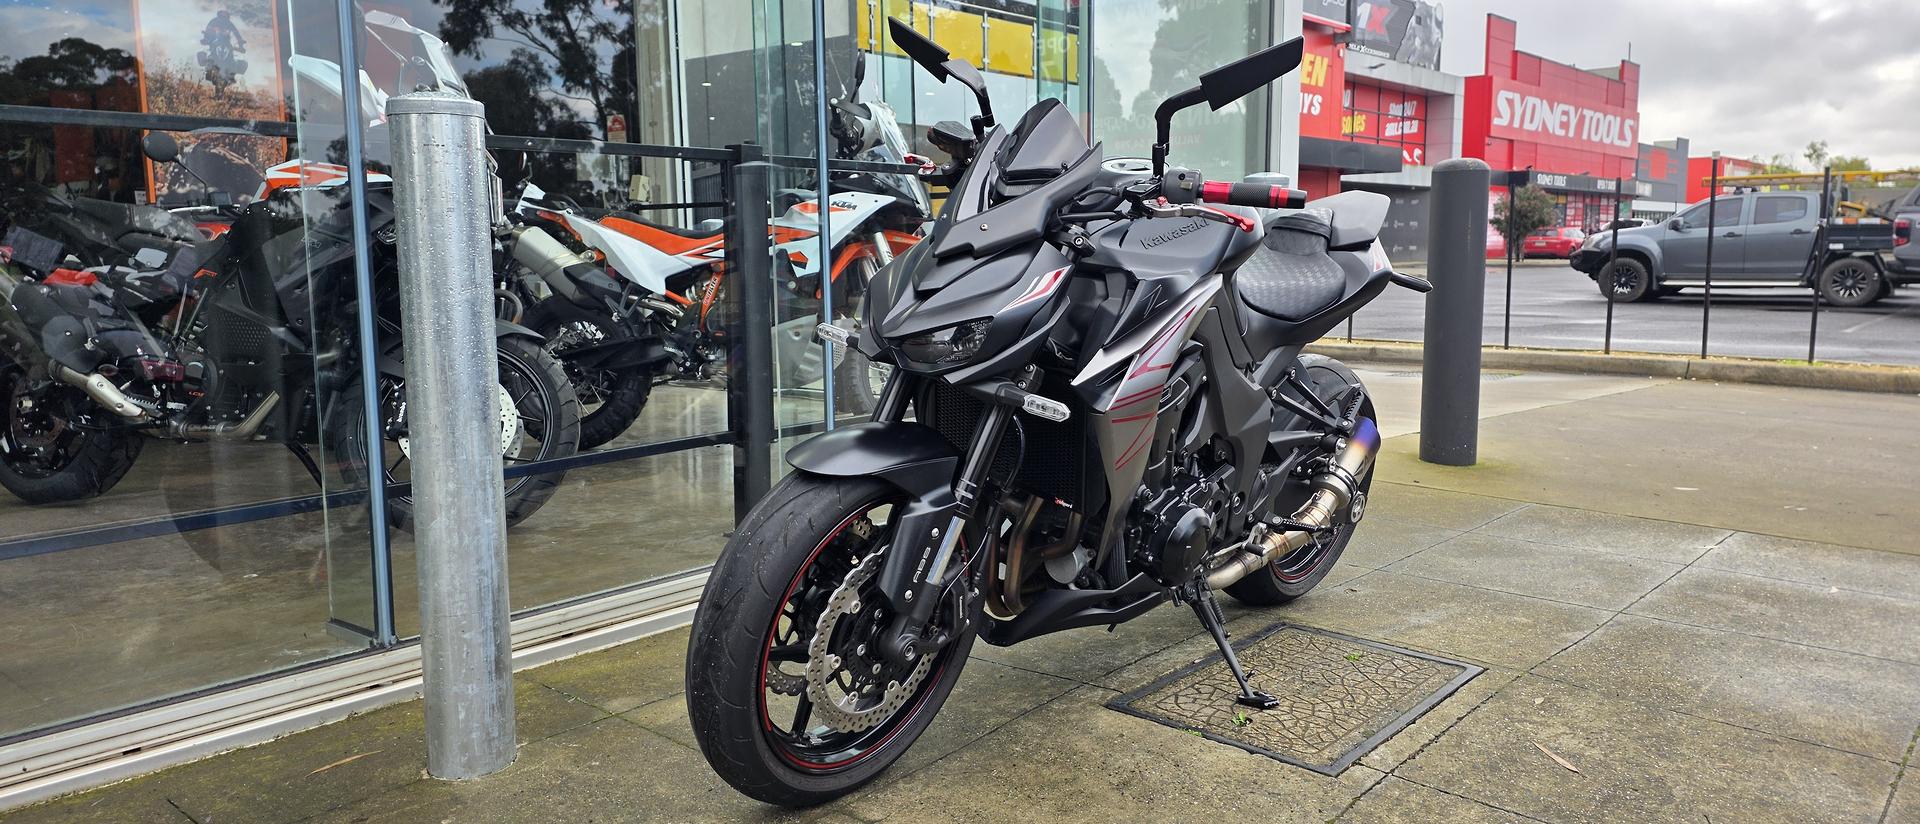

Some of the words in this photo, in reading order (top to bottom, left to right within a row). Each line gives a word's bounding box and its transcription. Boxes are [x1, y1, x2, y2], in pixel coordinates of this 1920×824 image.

[1493, 90, 1582, 138] SYDNEY
[1582, 108, 1635, 148] TOOLS
[831, 200, 858, 211] KTM
[1140, 217, 1210, 250] Kawasaki
[913, 546, 931, 583] ABS
